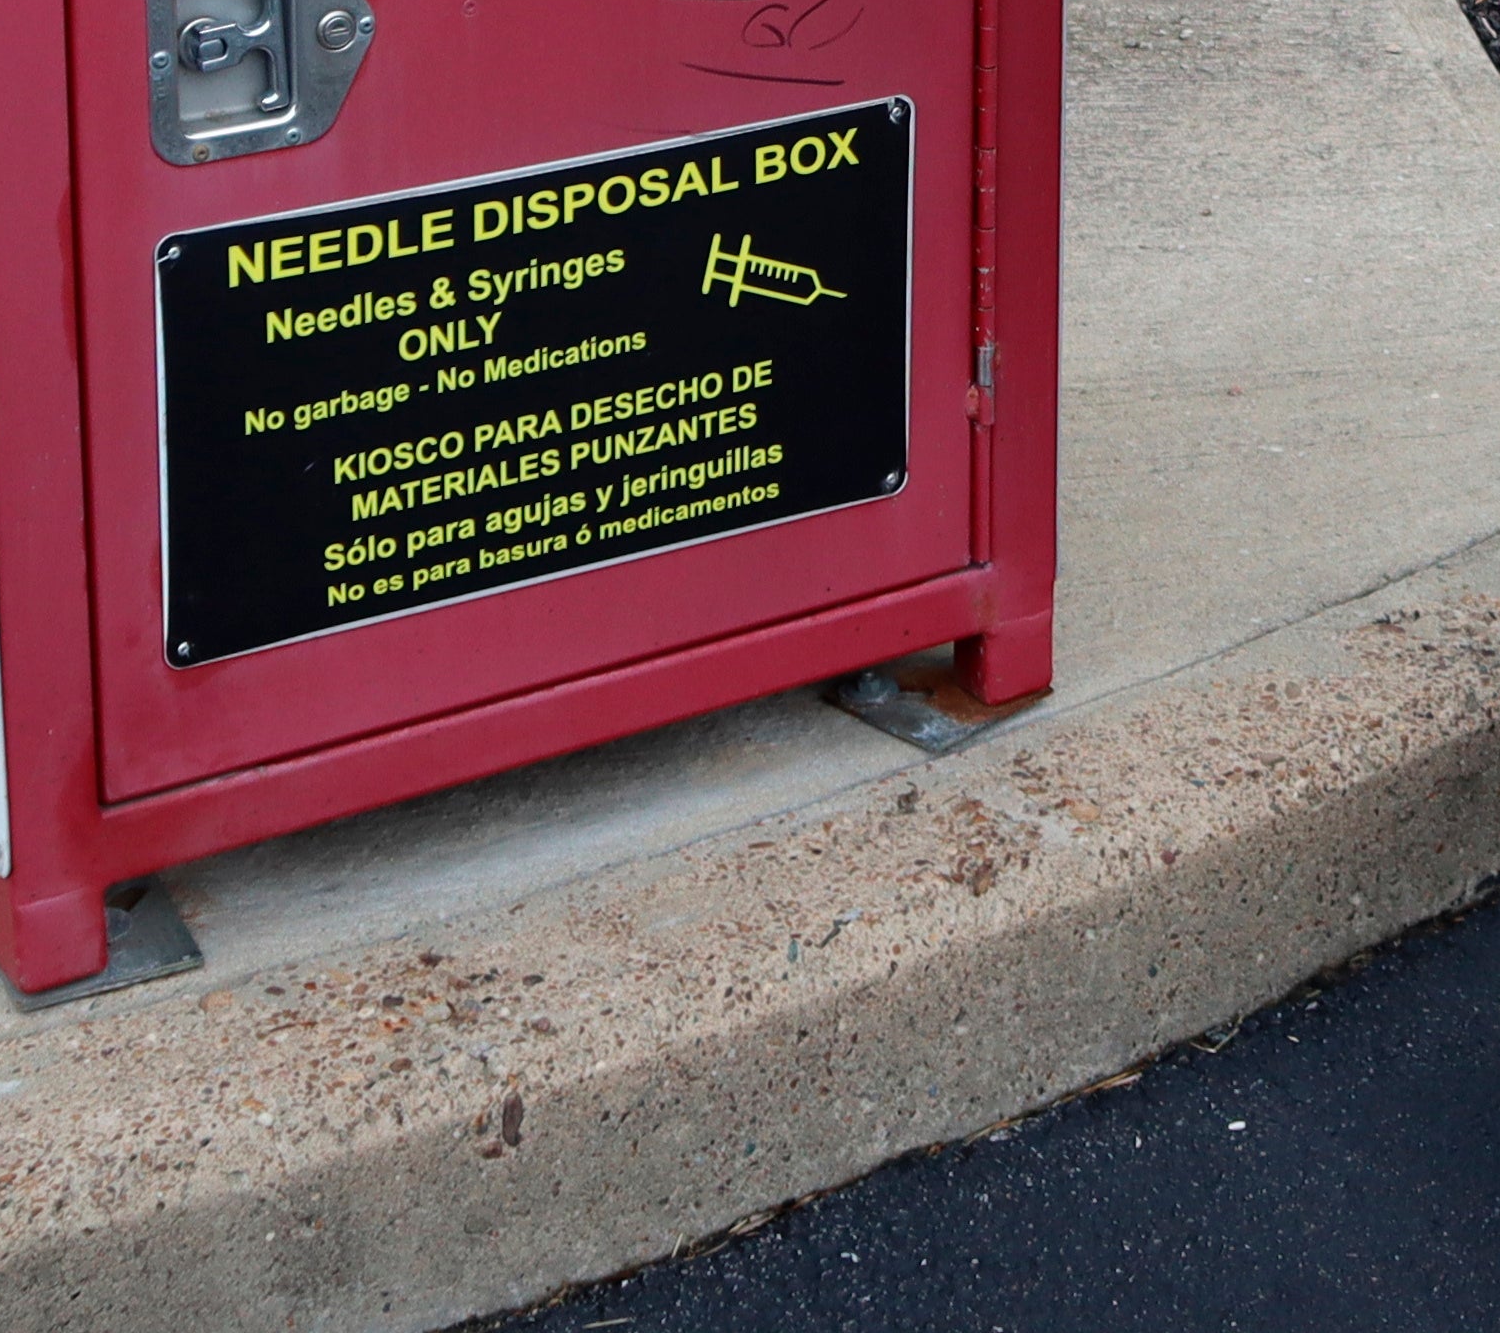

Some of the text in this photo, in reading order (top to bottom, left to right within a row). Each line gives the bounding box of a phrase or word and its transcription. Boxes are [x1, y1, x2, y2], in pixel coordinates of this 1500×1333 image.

[228, 127, 860, 288] NEEDLE DISPOSAL BOX
[266, 249, 625, 344] Needles & Syringes
[398, 311, 502, 362] ONLY
[244, 407, 285, 436] No
[293, 383, 410, 431] garbage
[437, 366, 476, 394] No
[484, 331, 647, 384] Medications
[334, 359, 773, 485] KIOSCO PARA DESECHO DE
[323, 444, 783, 571] Sólo para agujas y jeringuillas
[352, 402, 757, 524] MATERIALES PUNZANTES
[327, 482, 780, 607] No es para basura ó medicamentos
